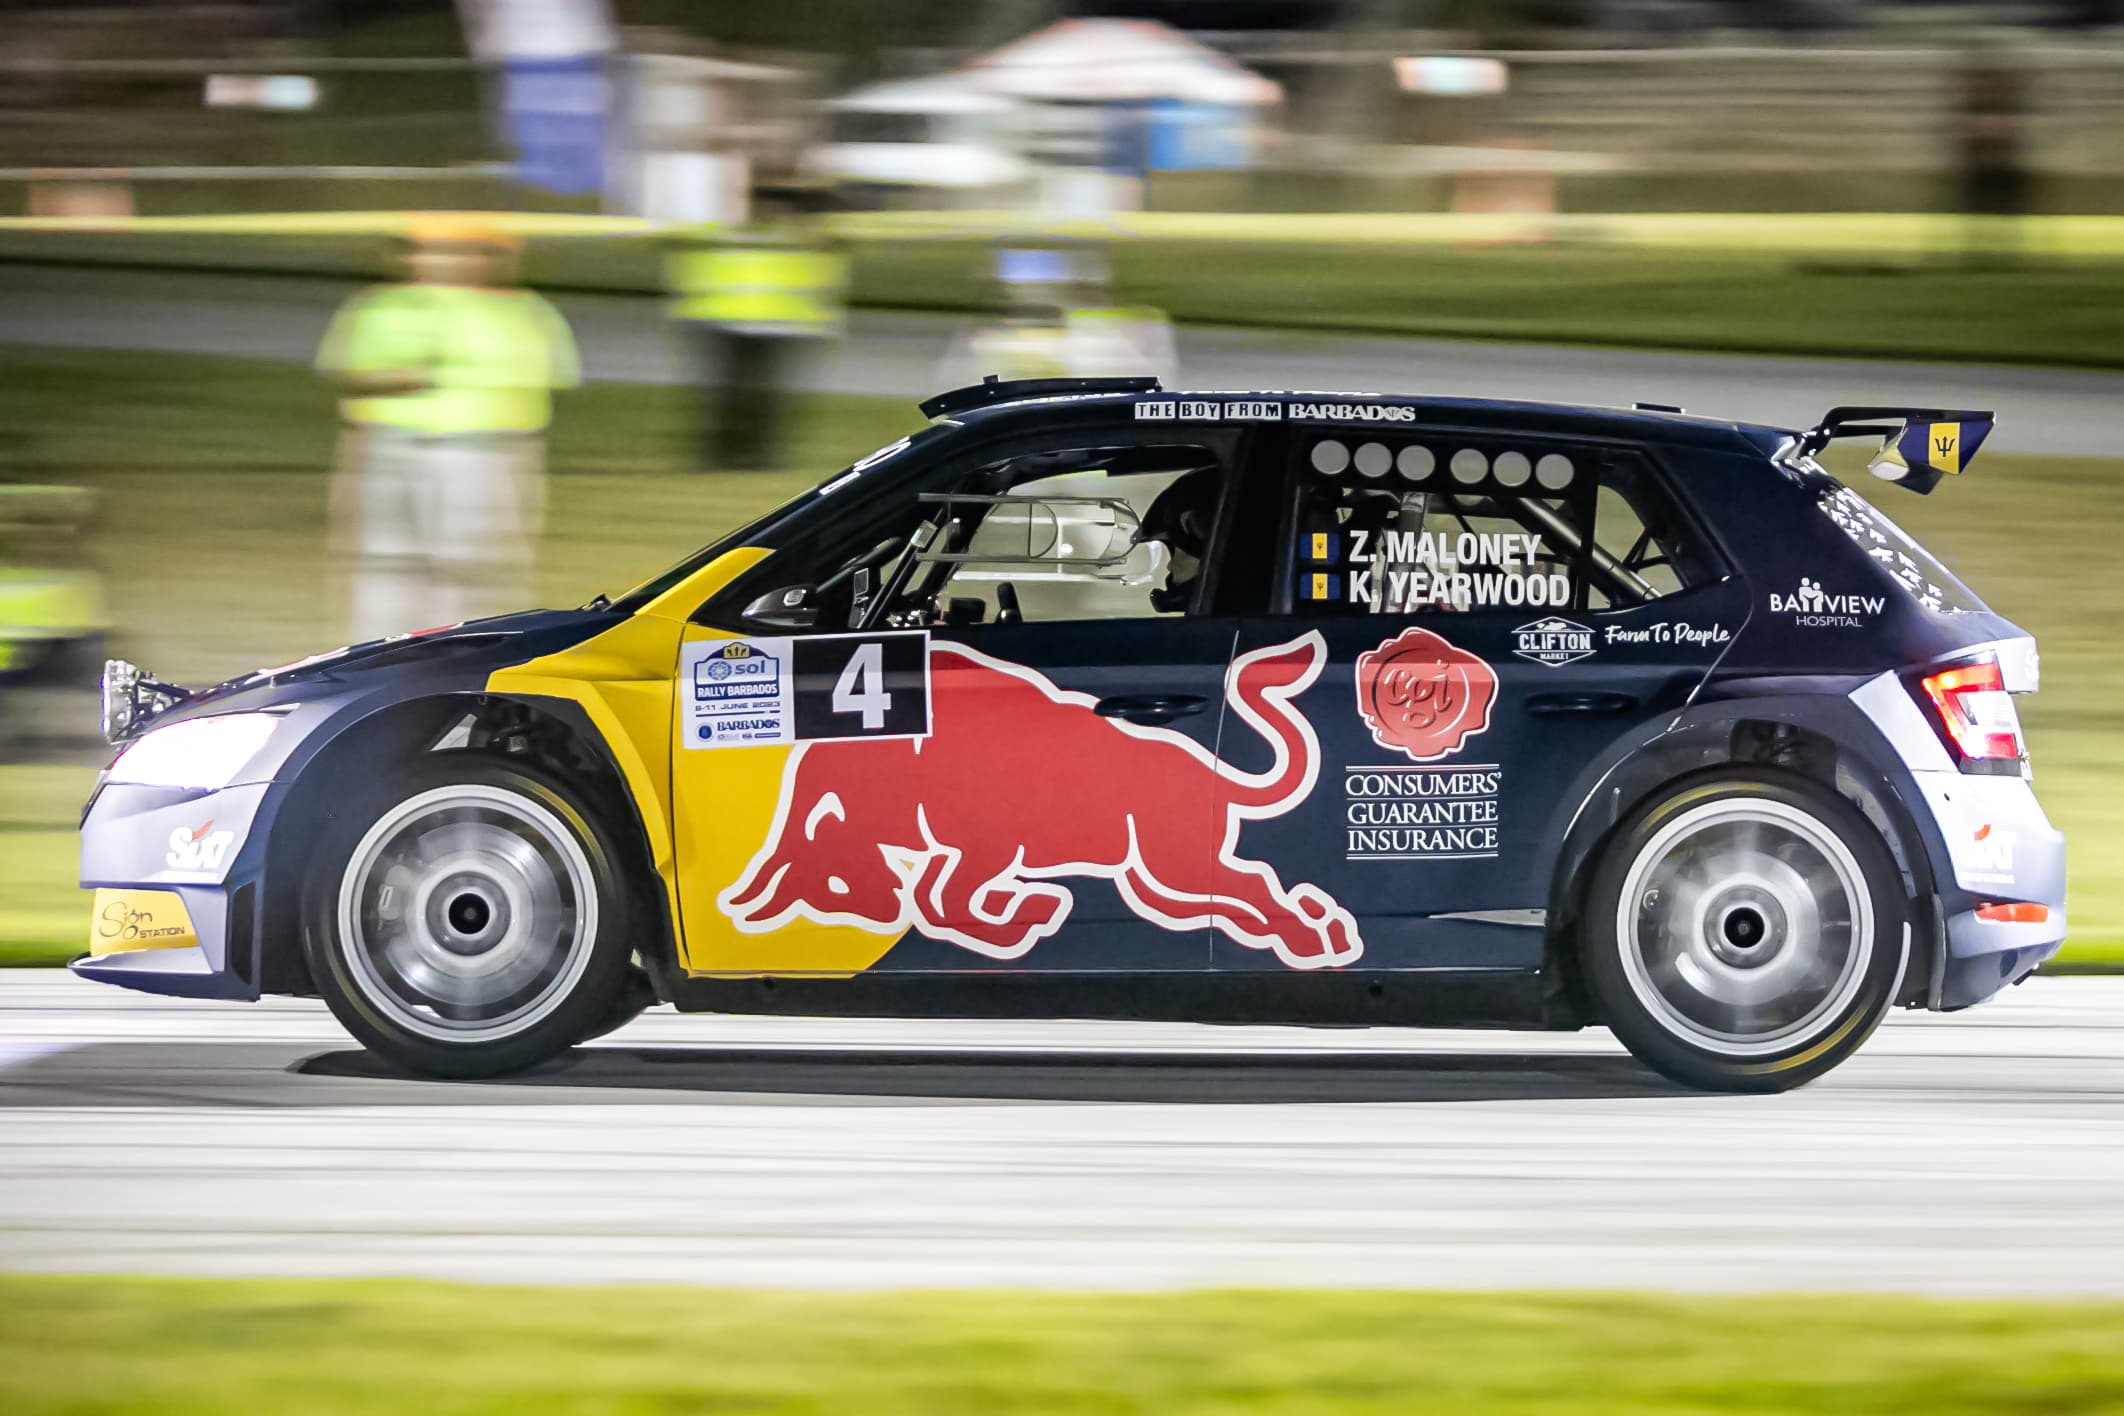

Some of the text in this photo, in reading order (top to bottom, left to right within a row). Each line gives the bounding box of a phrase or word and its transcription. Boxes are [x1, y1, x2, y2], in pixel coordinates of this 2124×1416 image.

[1137, 403, 1416, 422] THE BOY FROM BARBADOS
[1349, 530, 1542, 565] Z. MALONEY
[1390, 571, 1570, 607] YEARWOOD
[1796, 615, 1863, 628] HOSPITAL
[1518, 633, 1591, 650] CLIFTON
[1604, 622, 1731, 647] Farm To People
[734, 660, 766, 675] sol
[697, 683, 778, 698] RALLY BARBADOS
[832, 643, 892, 729] 4
[720, 702, 749, 710] JUNE
[717, 718, 781, 732] BARBADOS
[1347, 800, 1499, 825] GUARANTEE
[1347, 827, 1499, 851] INSURANCE
[140, 926, 185, 939] STATION
